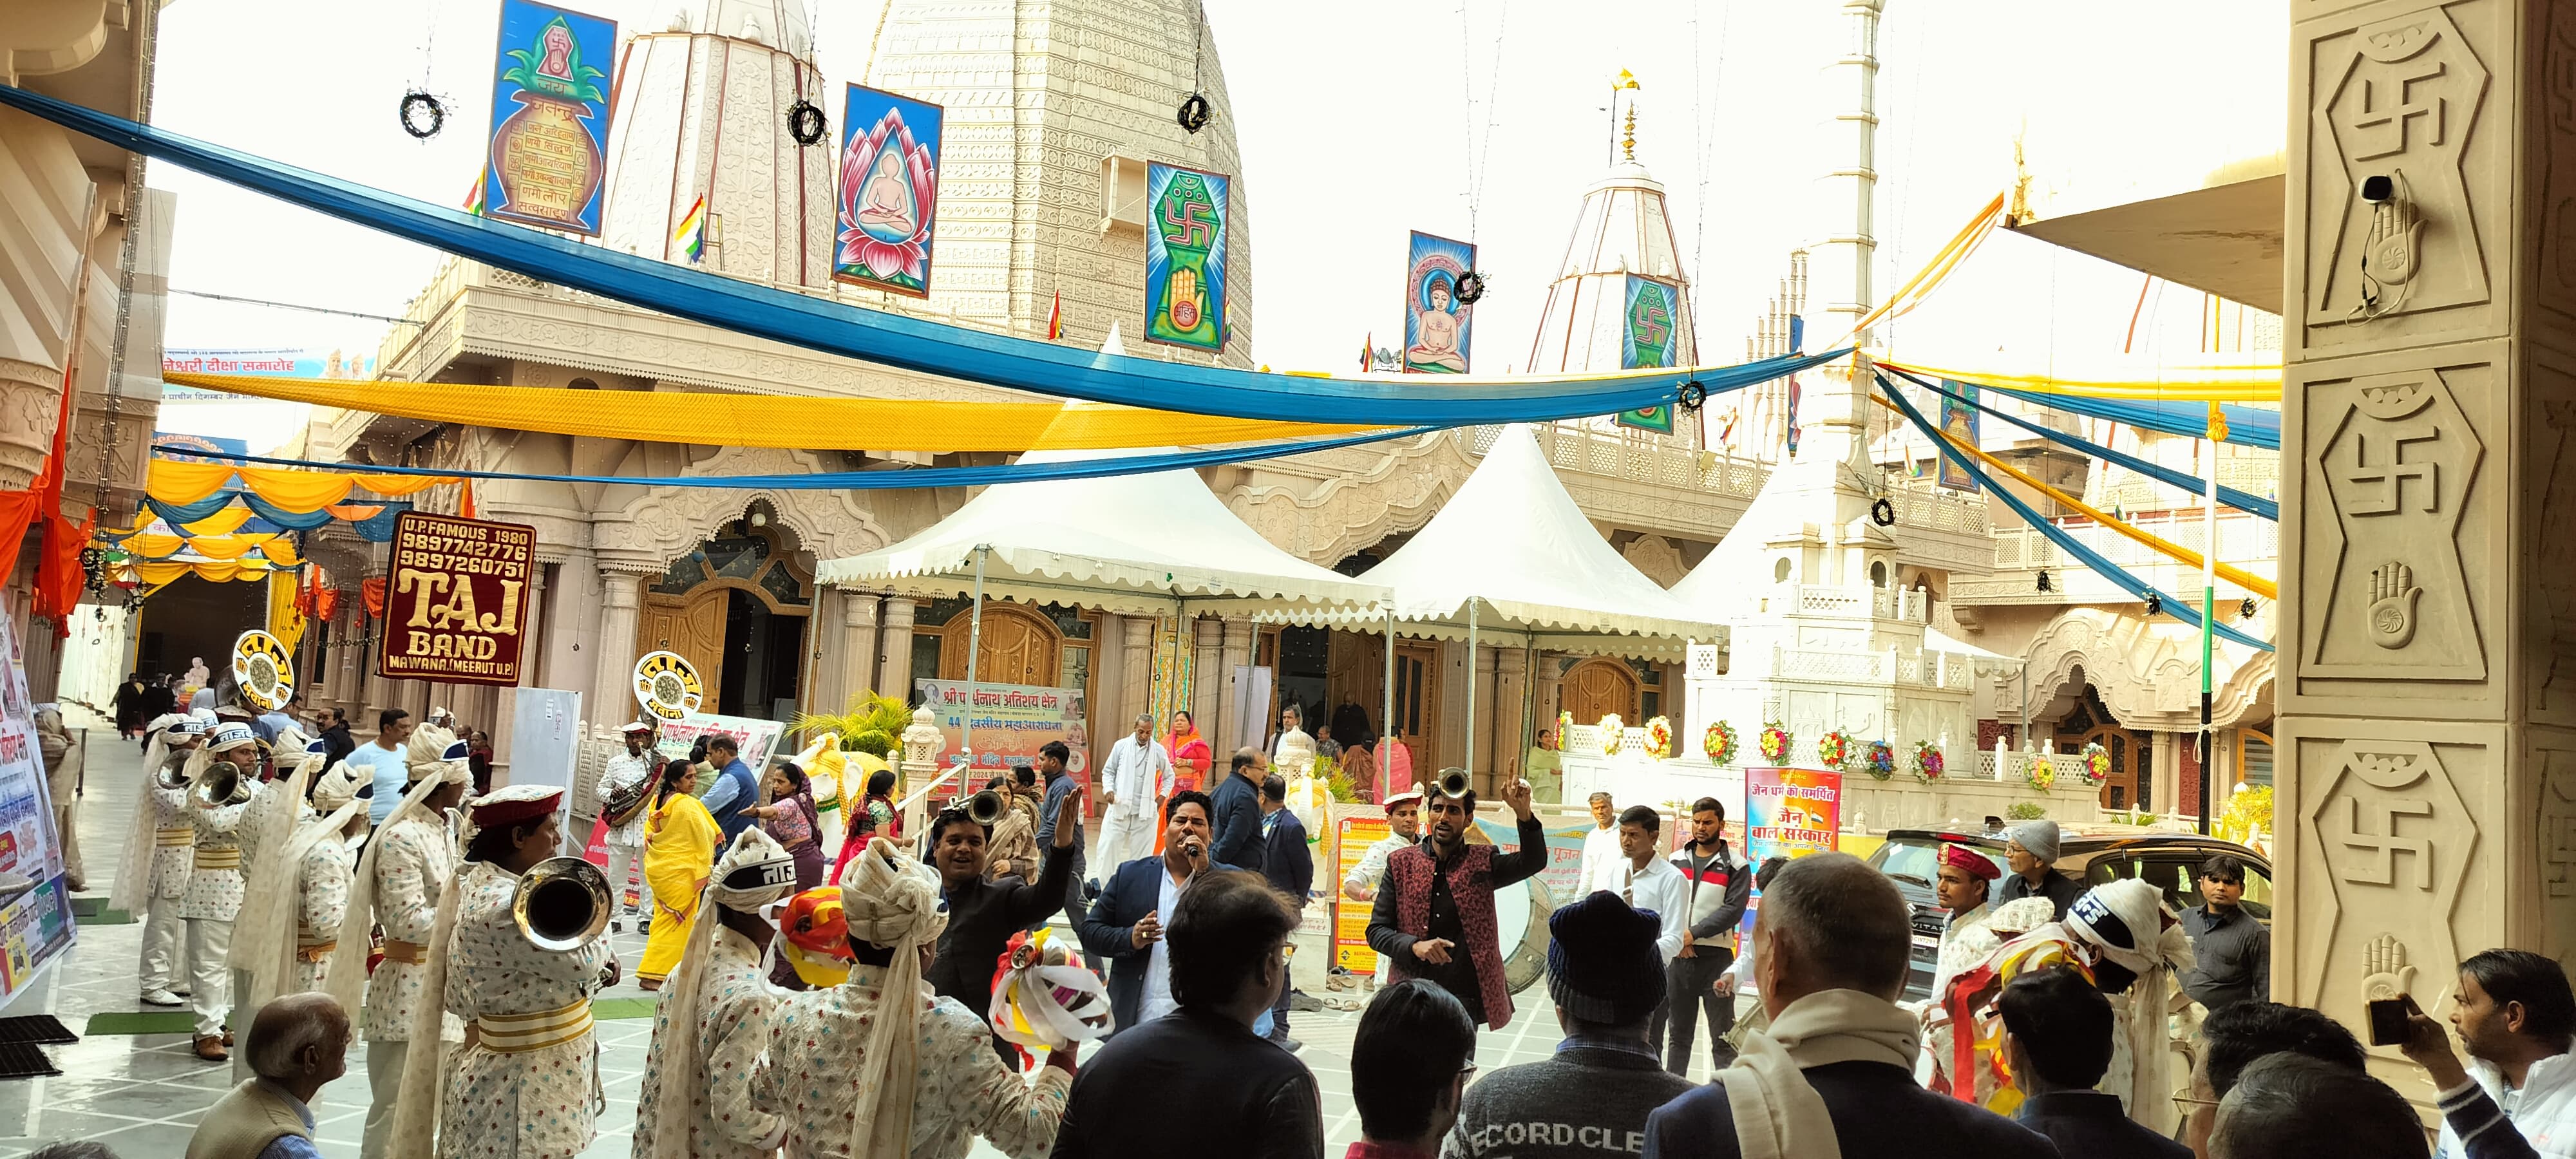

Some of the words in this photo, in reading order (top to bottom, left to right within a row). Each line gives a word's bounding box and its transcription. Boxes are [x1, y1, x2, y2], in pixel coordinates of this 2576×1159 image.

[537, 78, 569, 95] जय
[206, 357, 238, 371] दीक्षा
[242, 357, 294, 371] समारोह
[169, 391, 192, 400] प्राचीन
[195, 391, 223, 400] दिगम्बर
[428, 522, 488, 540] FAMOUS
[495, 530, 528, 545] 1980
[402, 532, 527, 561] 9897742776
[400, 550, 525, 578] 9897260751
[397, 568, 524, 636] TAJ
[406, 630, 497, 660] BAND
[943, 688, 957, 705] श्री
[1003, 691, 1039, 708] अतिशय
[1041, 692, 1057, 709] क्षेत्र
[949, 717, 961, 727] 44
[1752, 784, 1768, 796] जैन
[1772, 785, 1784, 796] धर्म
[1786, 785, 1799, 796] को
[1801, 787, 1834, 800] समर्पित
[1778, 807, 1804, 824] जैन
[1752, 827, 1779, 838] बाल
[1555, 847, 1581, 863] पूजन
